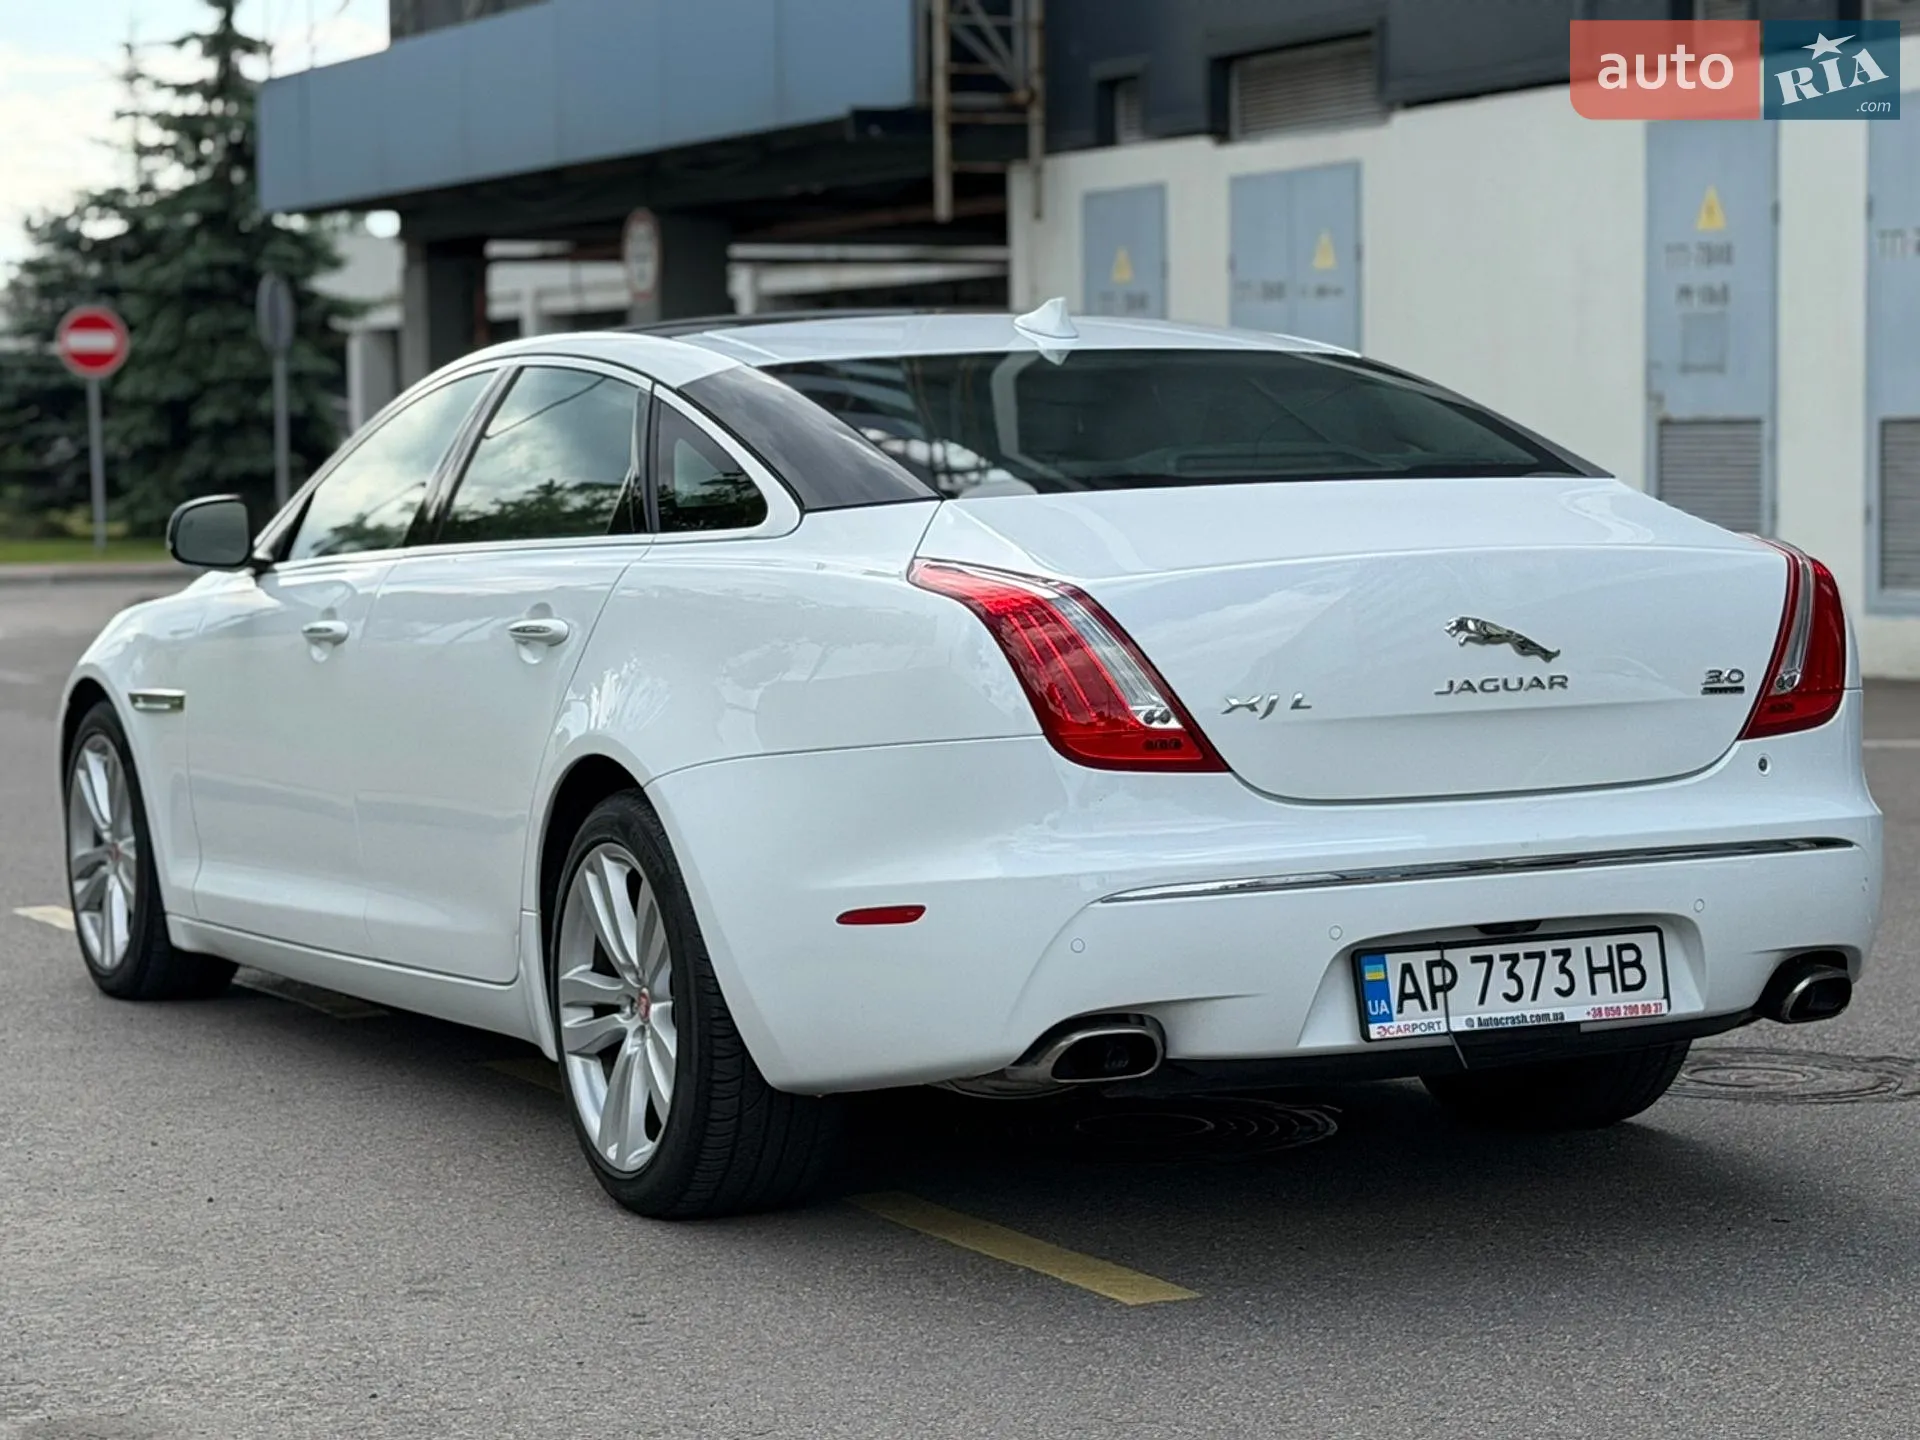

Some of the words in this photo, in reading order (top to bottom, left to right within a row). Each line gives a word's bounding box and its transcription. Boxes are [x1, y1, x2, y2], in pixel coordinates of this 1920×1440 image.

[1434, 675, 1569, 695] JAGUAR
[1396, 958, 1458, 1015] AP
[1469, 947, 1576, 1006] 7373
[1586, 942, 1647, 996] HB
[1367, 999, 1390, 1016] UA
